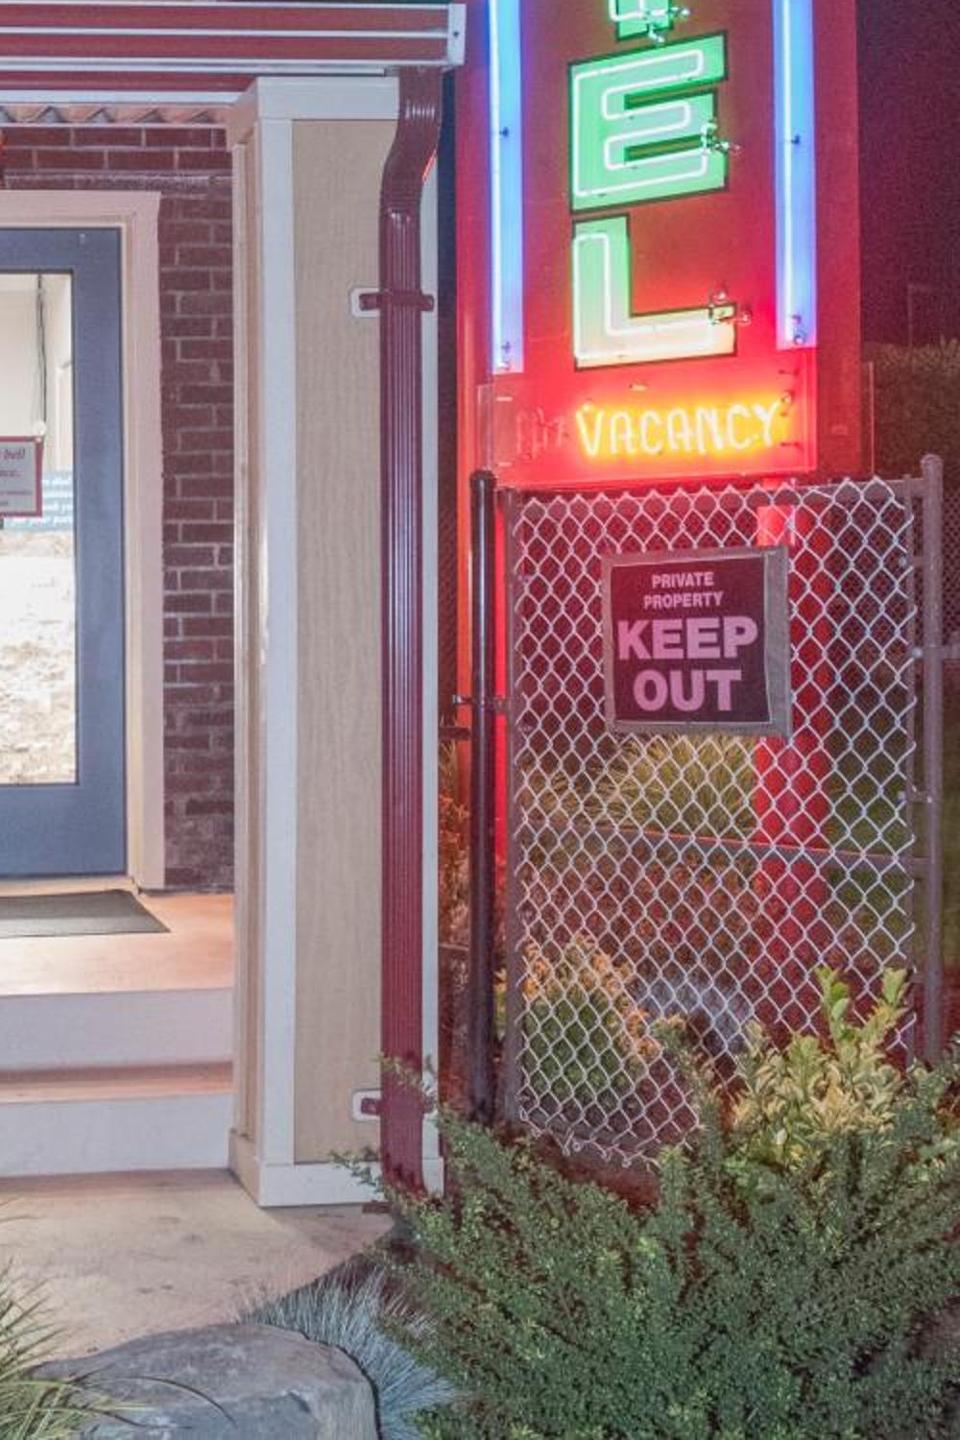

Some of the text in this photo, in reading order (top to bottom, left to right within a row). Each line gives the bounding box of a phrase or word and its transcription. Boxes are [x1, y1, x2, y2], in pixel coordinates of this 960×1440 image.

[575, 398, 784, 457] VACANCY
[3, 447, 25, 460] bell
[651, 571, 715, 589] PRIVATE
[643, 591, 724, 609] PROPERTY
[617, 616, 758, 660] KEEP
[633, 669, 742, 712] OUT
